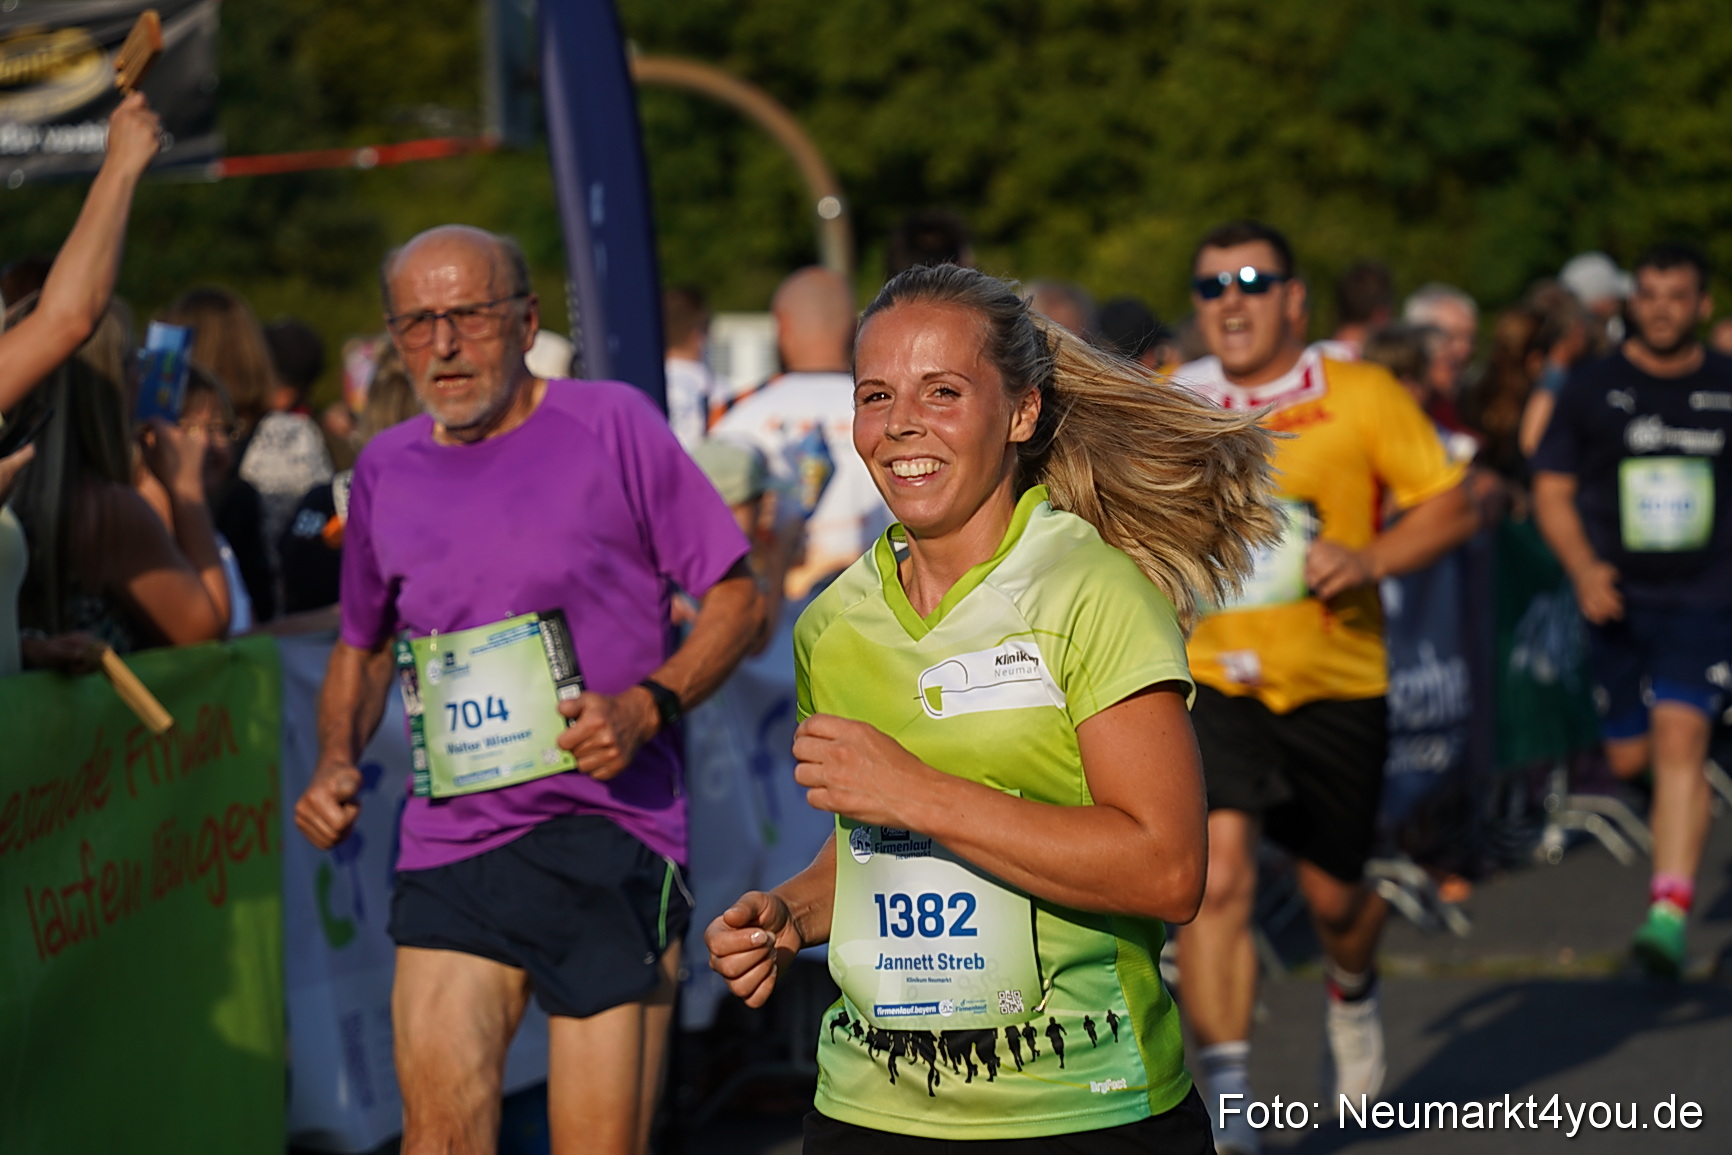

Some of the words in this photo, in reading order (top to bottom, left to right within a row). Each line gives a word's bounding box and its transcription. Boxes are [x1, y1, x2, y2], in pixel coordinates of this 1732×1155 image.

[446, 696, 510, 731] 704
[874, 837, 933, 853] Firmenlauf
[896, 850, 932, 861] neumarkt
[24, 838, 143, 962] laufen
[874, 892, 978, 938] 1382
[875, 953, 934, 970] Jannett
[938, 952, 985, 970] Streb
[876, 1004, 937, 1016] firmenlauf.bayern
